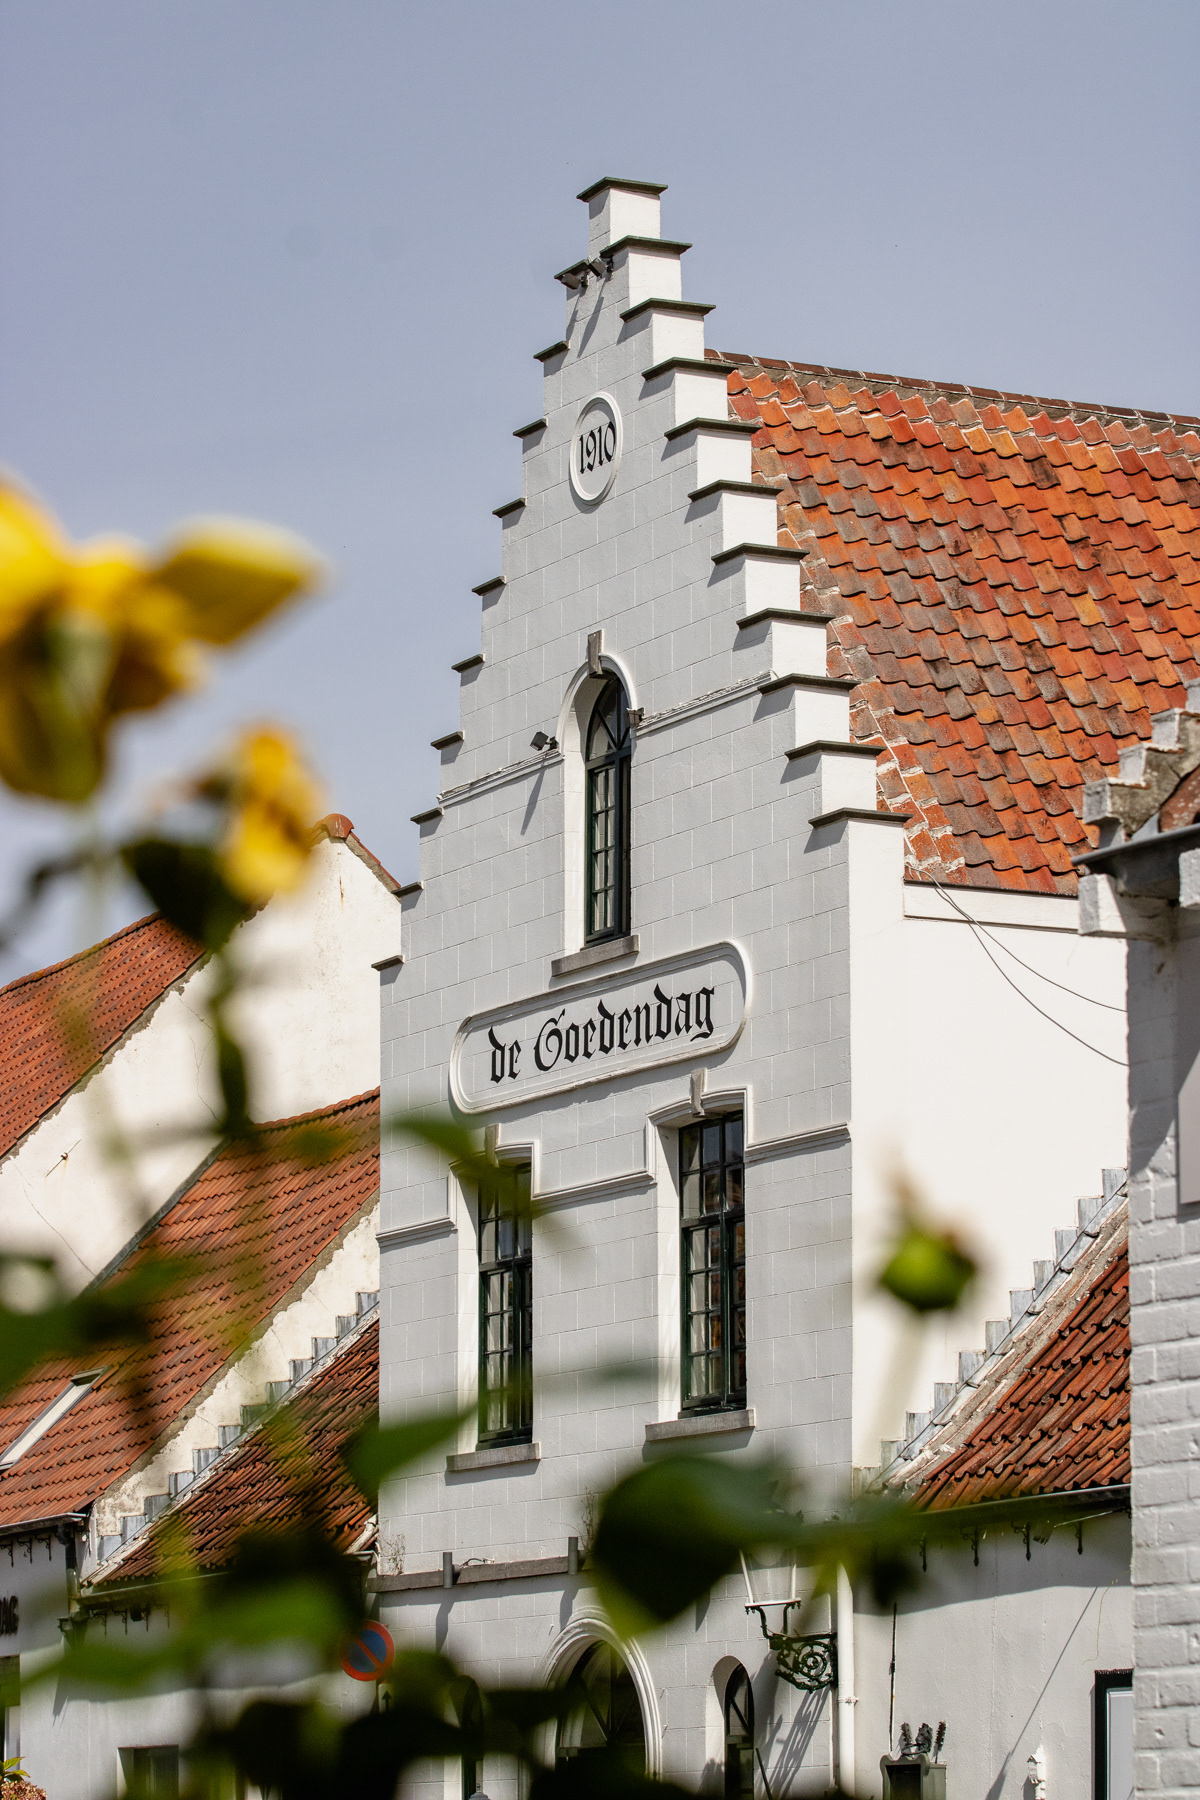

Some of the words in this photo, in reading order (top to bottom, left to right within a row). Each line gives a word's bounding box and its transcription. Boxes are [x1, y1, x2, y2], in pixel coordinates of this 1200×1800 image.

[579, 420, 616, 475] 1910
[488, 1026, 522, 1084] de
[534, 983, 715, 1072] Goedendag
